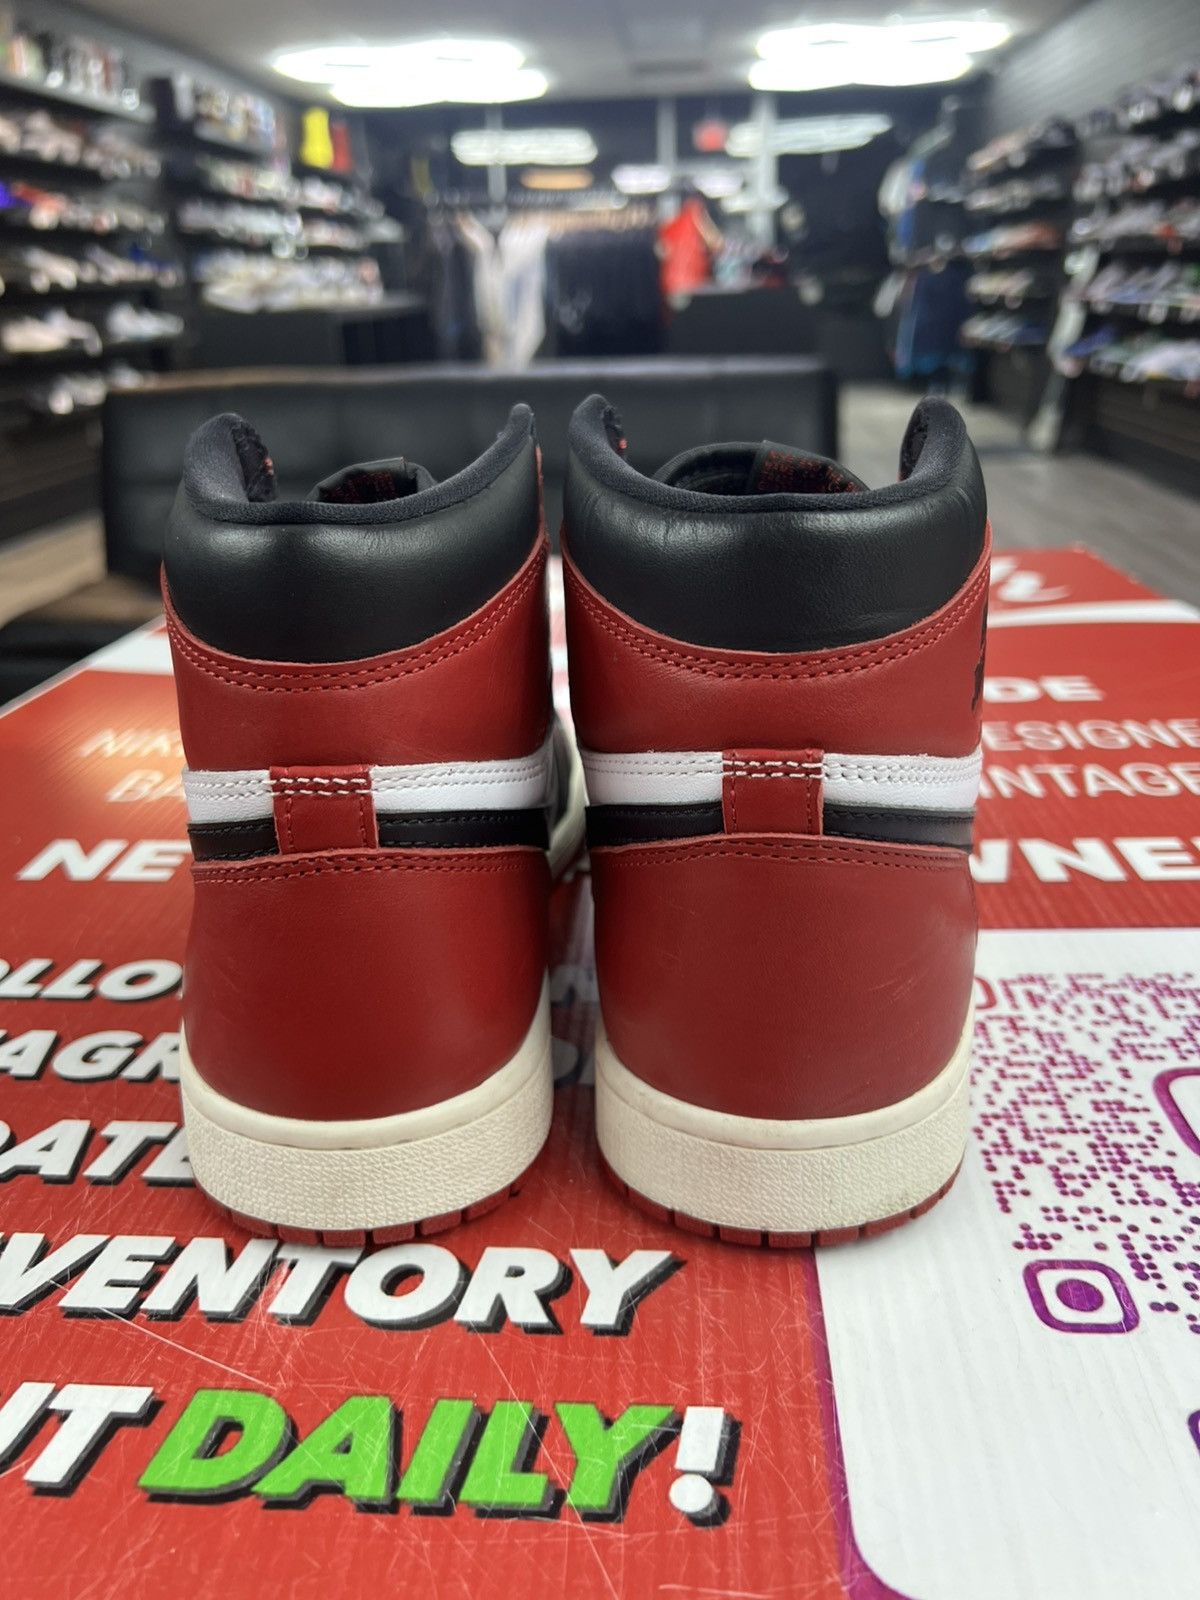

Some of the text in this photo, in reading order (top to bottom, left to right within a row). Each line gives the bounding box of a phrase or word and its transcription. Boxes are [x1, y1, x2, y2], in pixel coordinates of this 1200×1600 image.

[0, 1029, 182, 1083] AGR
[0, 1232, 682, 1336] VENTORY
[137, 1388, 740, 1525] DAILY!
